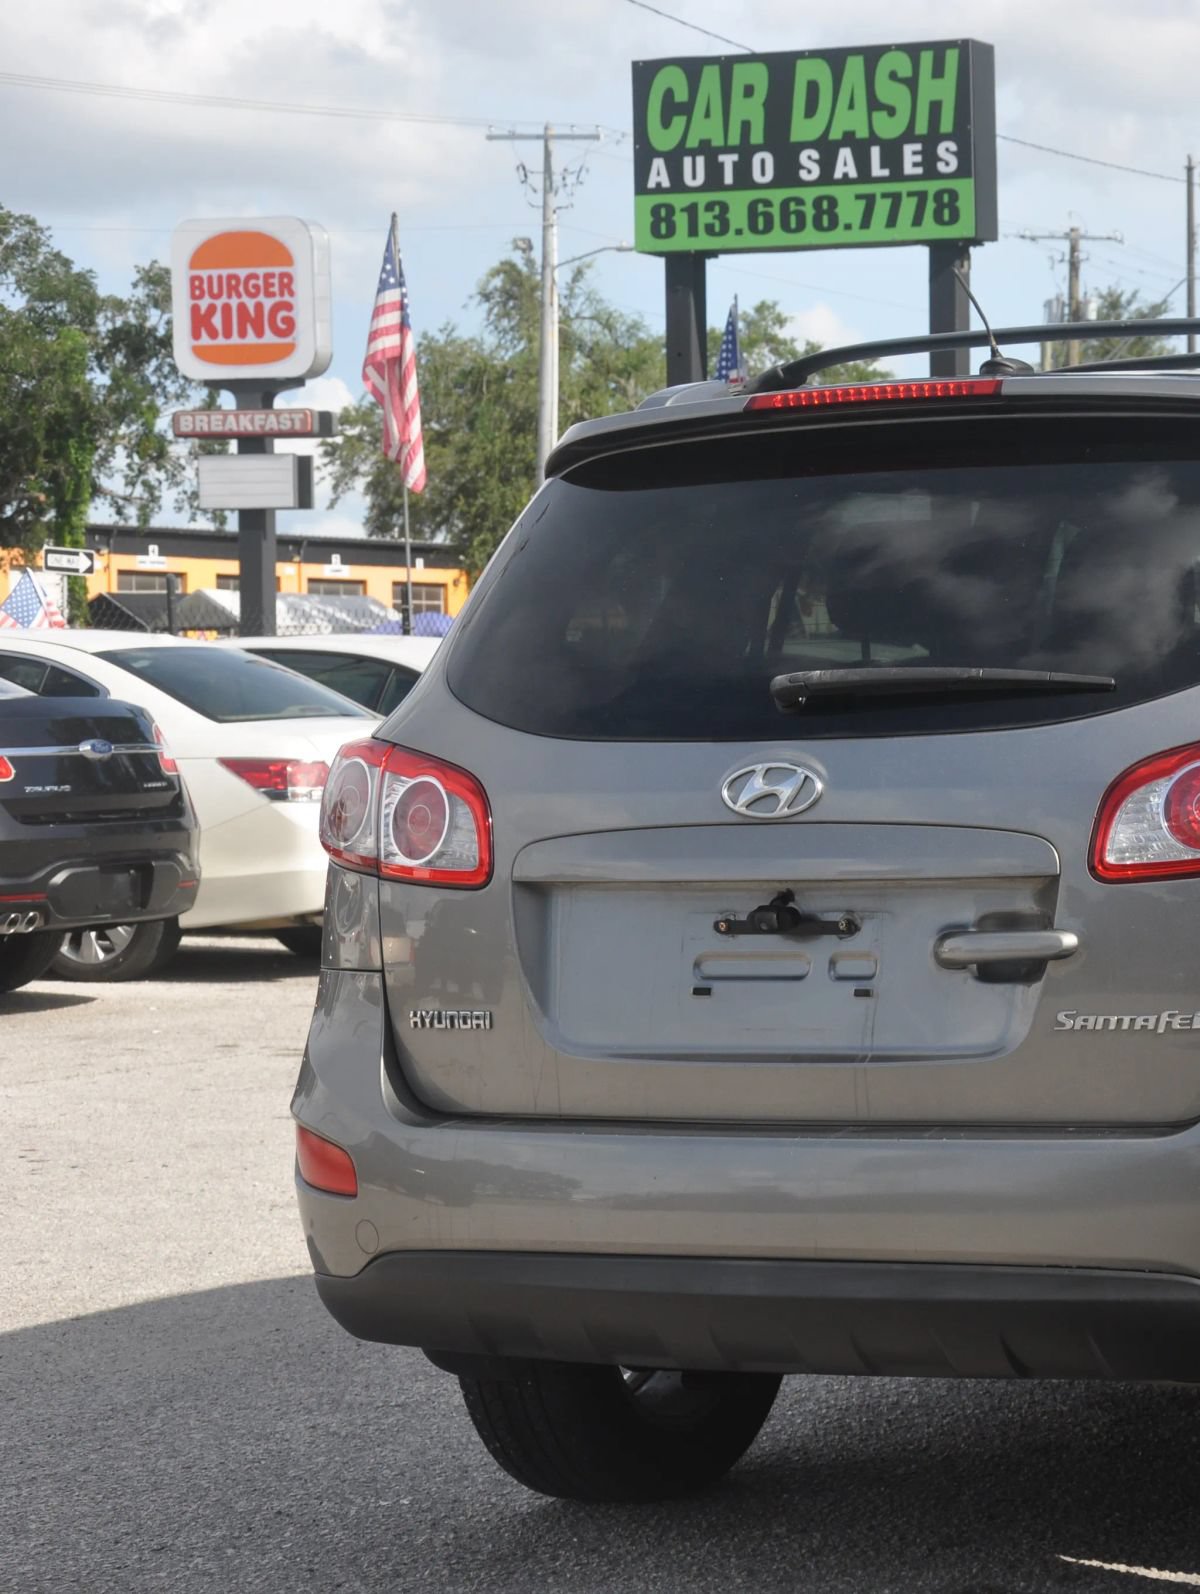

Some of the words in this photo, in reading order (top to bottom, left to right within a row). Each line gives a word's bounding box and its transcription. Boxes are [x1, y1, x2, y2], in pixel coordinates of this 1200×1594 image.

[646, 61, 769, 152] CAR
[790, 48, 960, 143] DASH
[647, 151, 775, 189] AUTO
[799, 140, 959, 178] SALES
[650, 188, 961, 239] 813.668.7778
[189, 271, 294, 300] BURGER
[190, 300, 296, 341] KING
[179, 412, 303, 433] BREAKFAST
[409, 1010, 491, 1030] HYUNDAI
